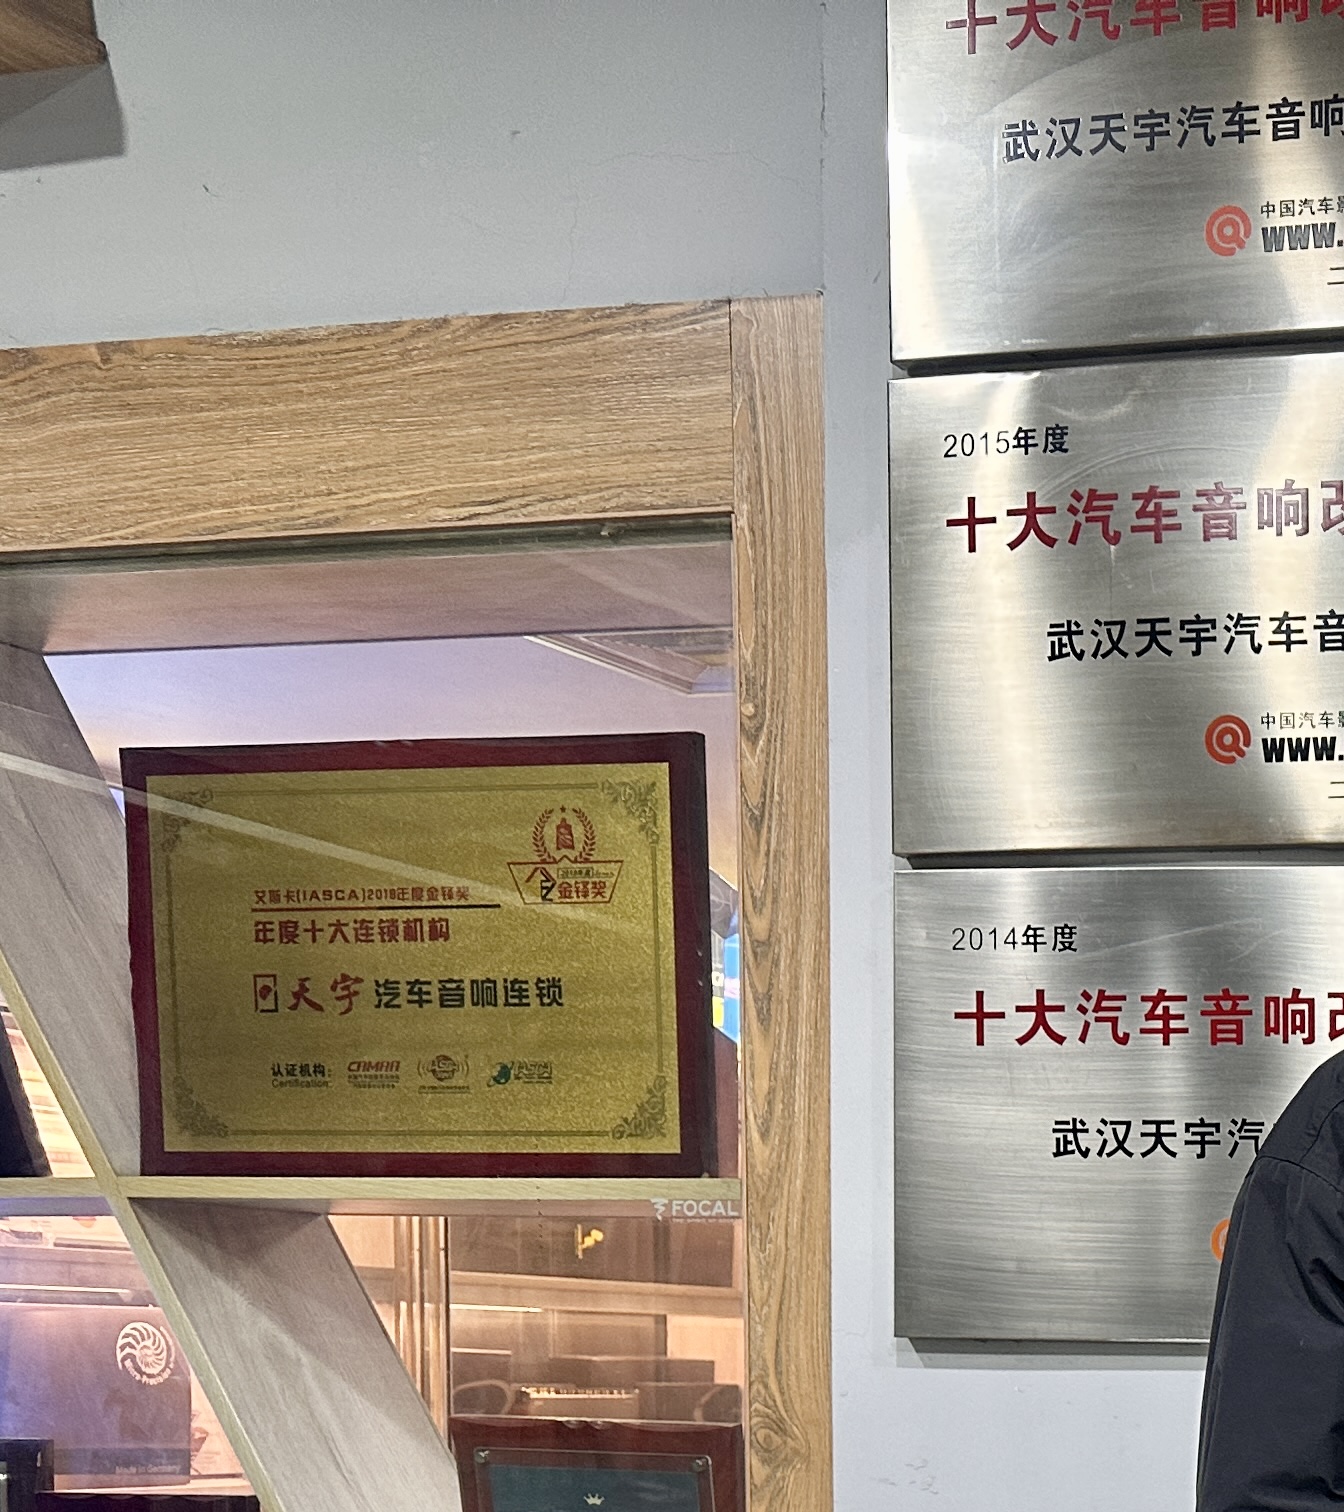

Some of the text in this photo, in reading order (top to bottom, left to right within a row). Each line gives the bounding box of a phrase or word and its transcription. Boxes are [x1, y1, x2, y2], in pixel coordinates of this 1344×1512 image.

[942, 424, 1070, 460] 2015年度
[253, 916, 451, 945] 年度十大连锁机构
[951, 923, 1079, 954] 2014年度
[373, 976, 564, 1009] 汽车音响连锁
[671, 1199, 740, 1217] FOCAL
